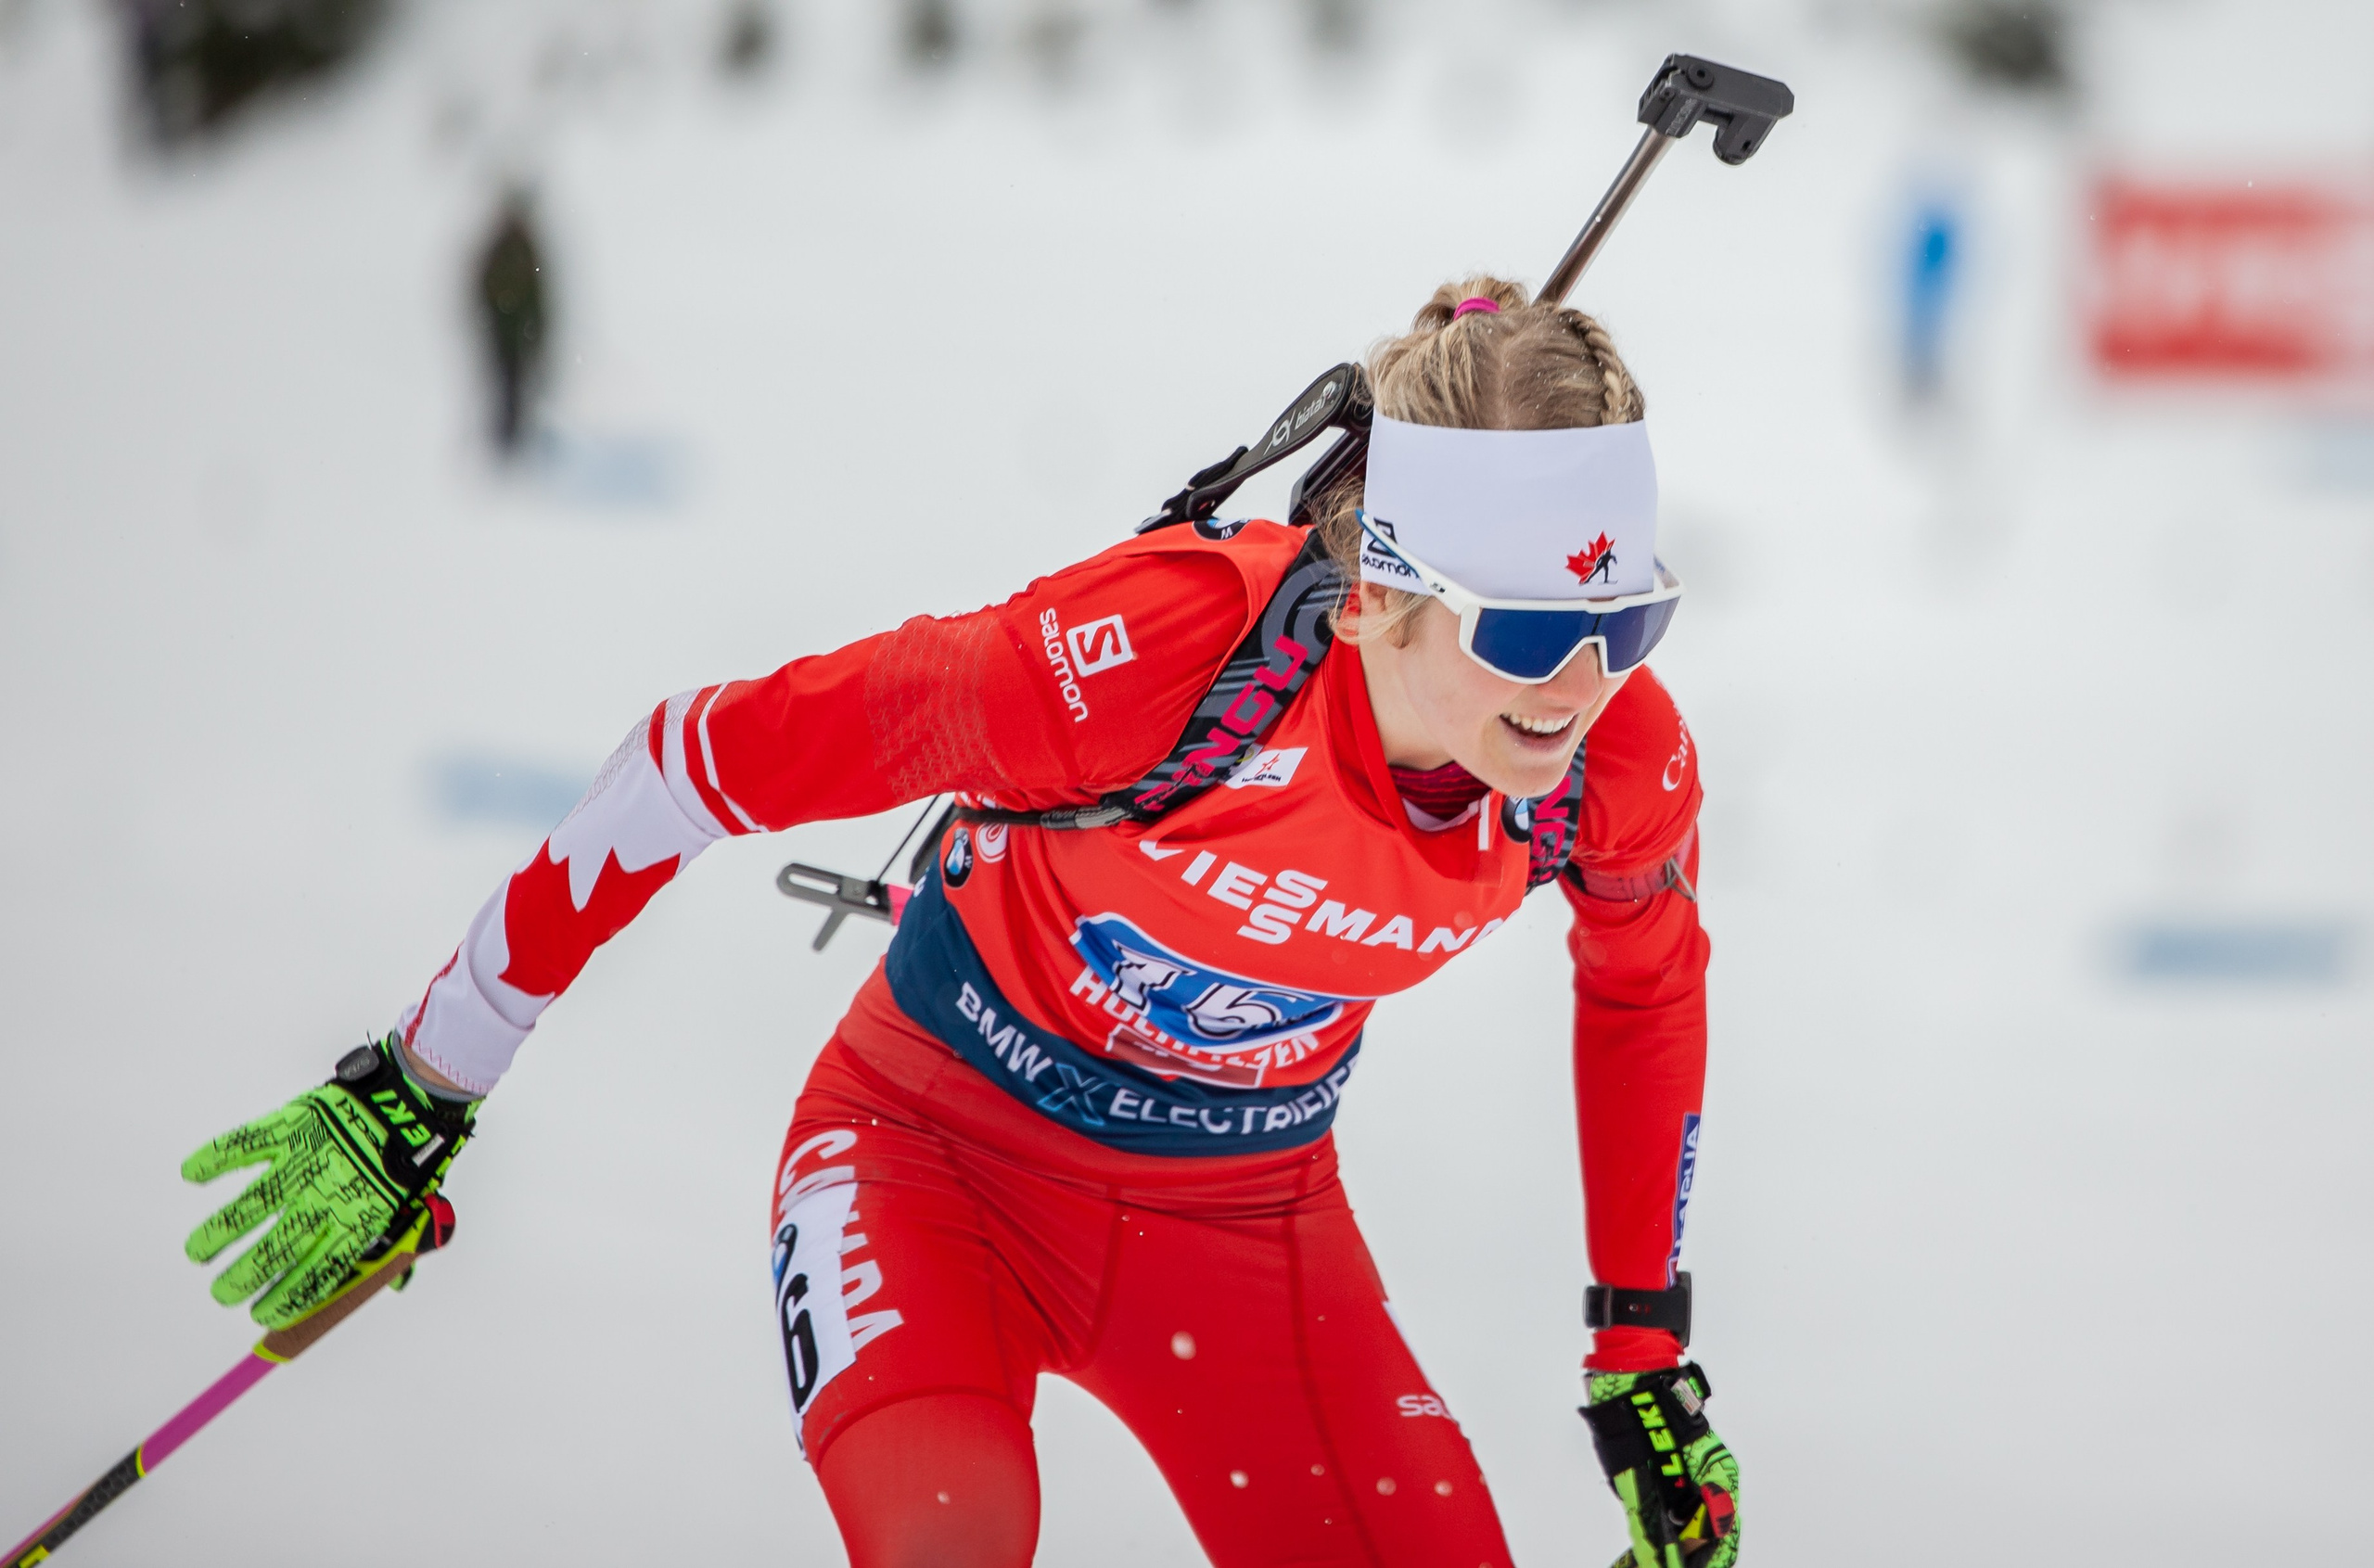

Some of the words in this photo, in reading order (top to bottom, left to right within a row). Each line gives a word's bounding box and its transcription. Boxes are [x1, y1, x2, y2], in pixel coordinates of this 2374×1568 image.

[1040, 607, 1089, 723] salomon
[956, 982, 1053, 1081] BMW
[1038, 1062, 1105, 1127] X
[1109, 1054, 1360, 1135] ELECTRIFIE
[370, 1089, 434, 1152] EKI
[1631, 1392, 1684, 1476] LEKI
